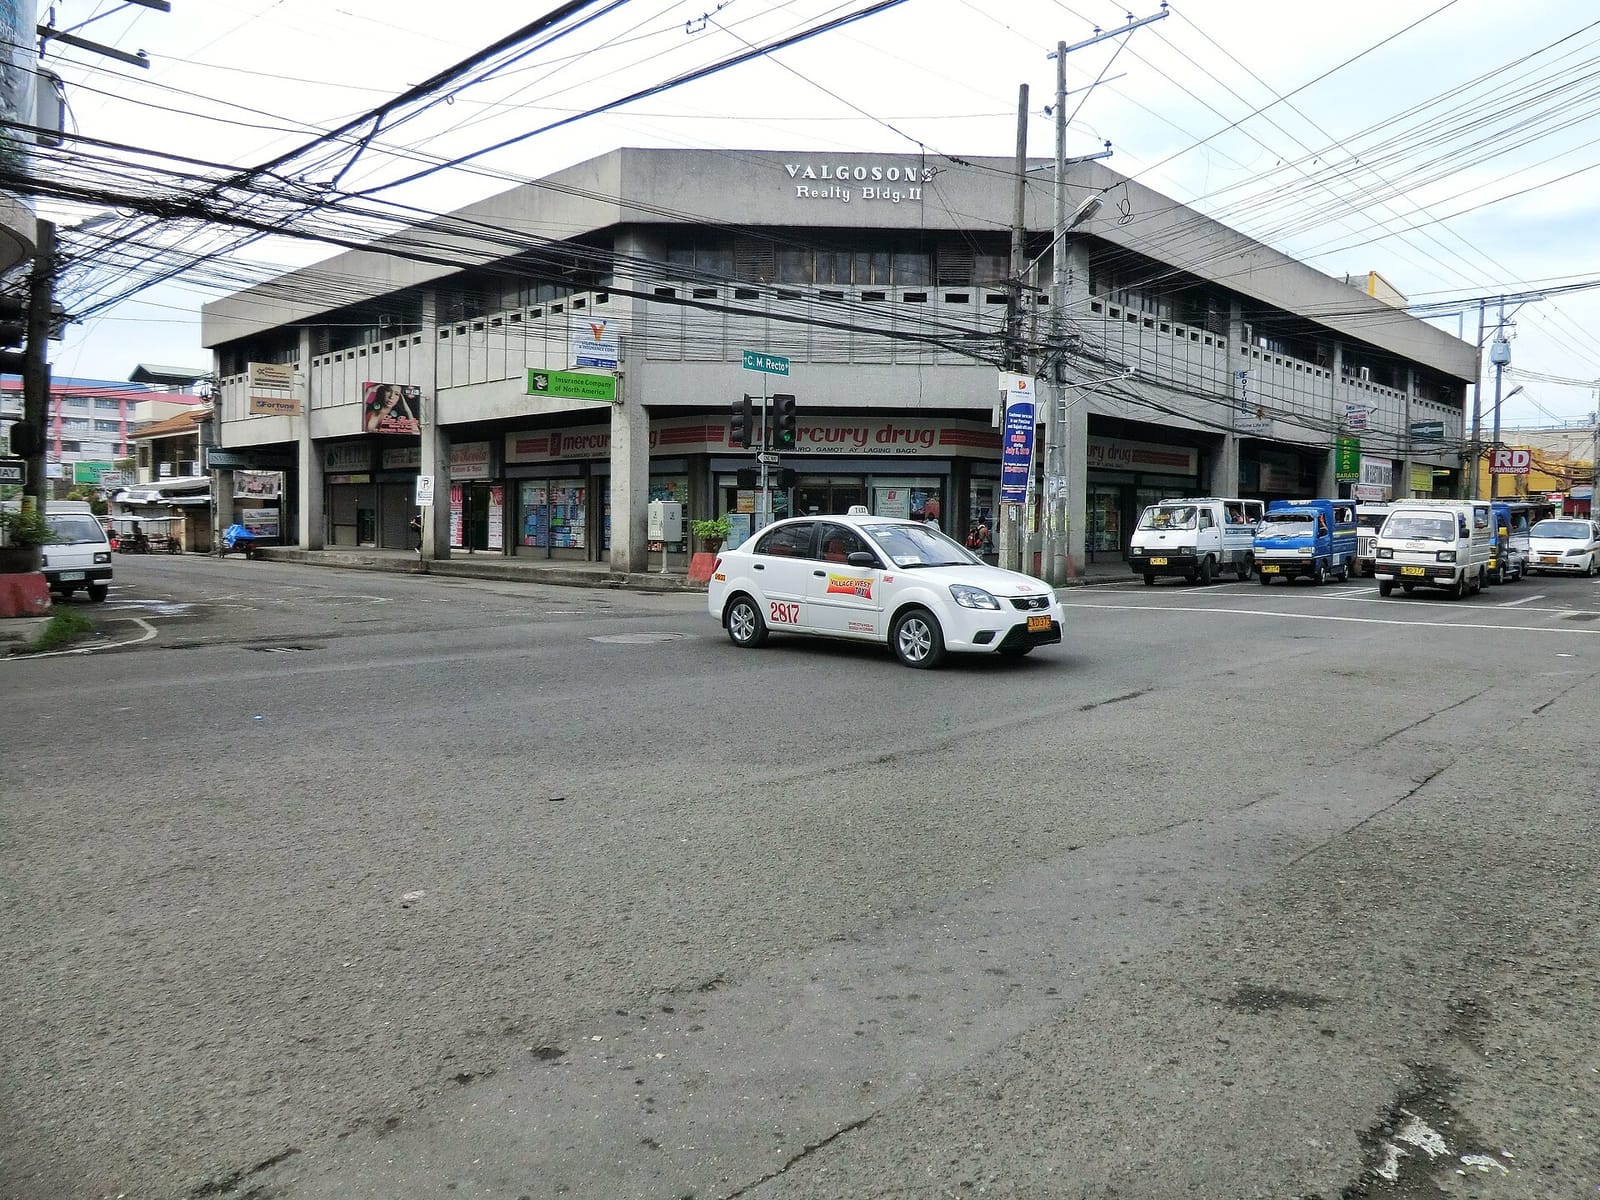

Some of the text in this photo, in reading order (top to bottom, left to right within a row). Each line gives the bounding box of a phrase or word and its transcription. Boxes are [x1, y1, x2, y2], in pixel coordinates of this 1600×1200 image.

[785, 164, 934, 183] VALGOSONS
[796, 185, 851, 203] Realty
[766, 359, 785, 371] Recto
[555, 376, 611, 388] Insurance Company
[562, 433, 611, 451] mercur
[757, 424, 936, 448] mrcury drug
[1108, 442, 1131, 464] drug
[1495, 451, 1530, 467] RD
[830, 578, 872, 588] VILLAGE WEST
[770, 602, 799, 623] 2817
